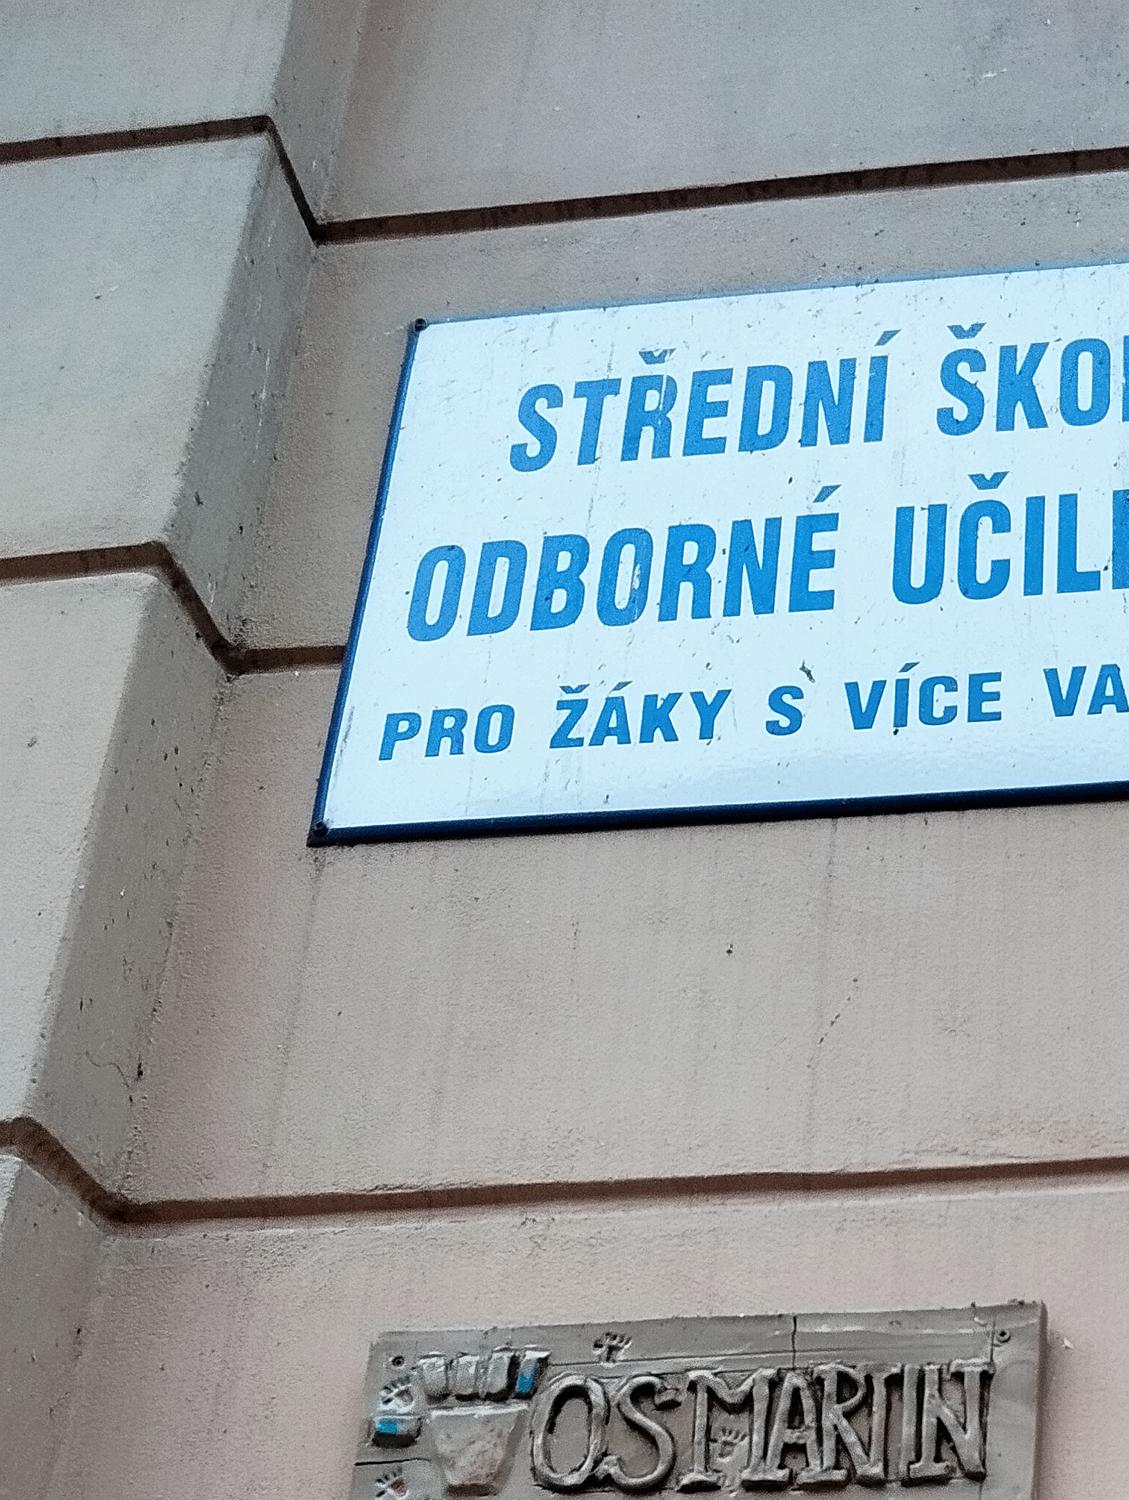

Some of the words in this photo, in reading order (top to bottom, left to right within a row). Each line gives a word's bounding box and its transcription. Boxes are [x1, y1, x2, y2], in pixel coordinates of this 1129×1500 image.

[510, 330, 900, 473] STŘEDNÍ
[406, 484, 840, 642] ODBORNÉ
[378, 704, 516, 762] PRO
[548, 681, 732, 750] ŽÁKY
[765, 684, 804, 736] S
[845, 662, 1003, 731] VÍCE
